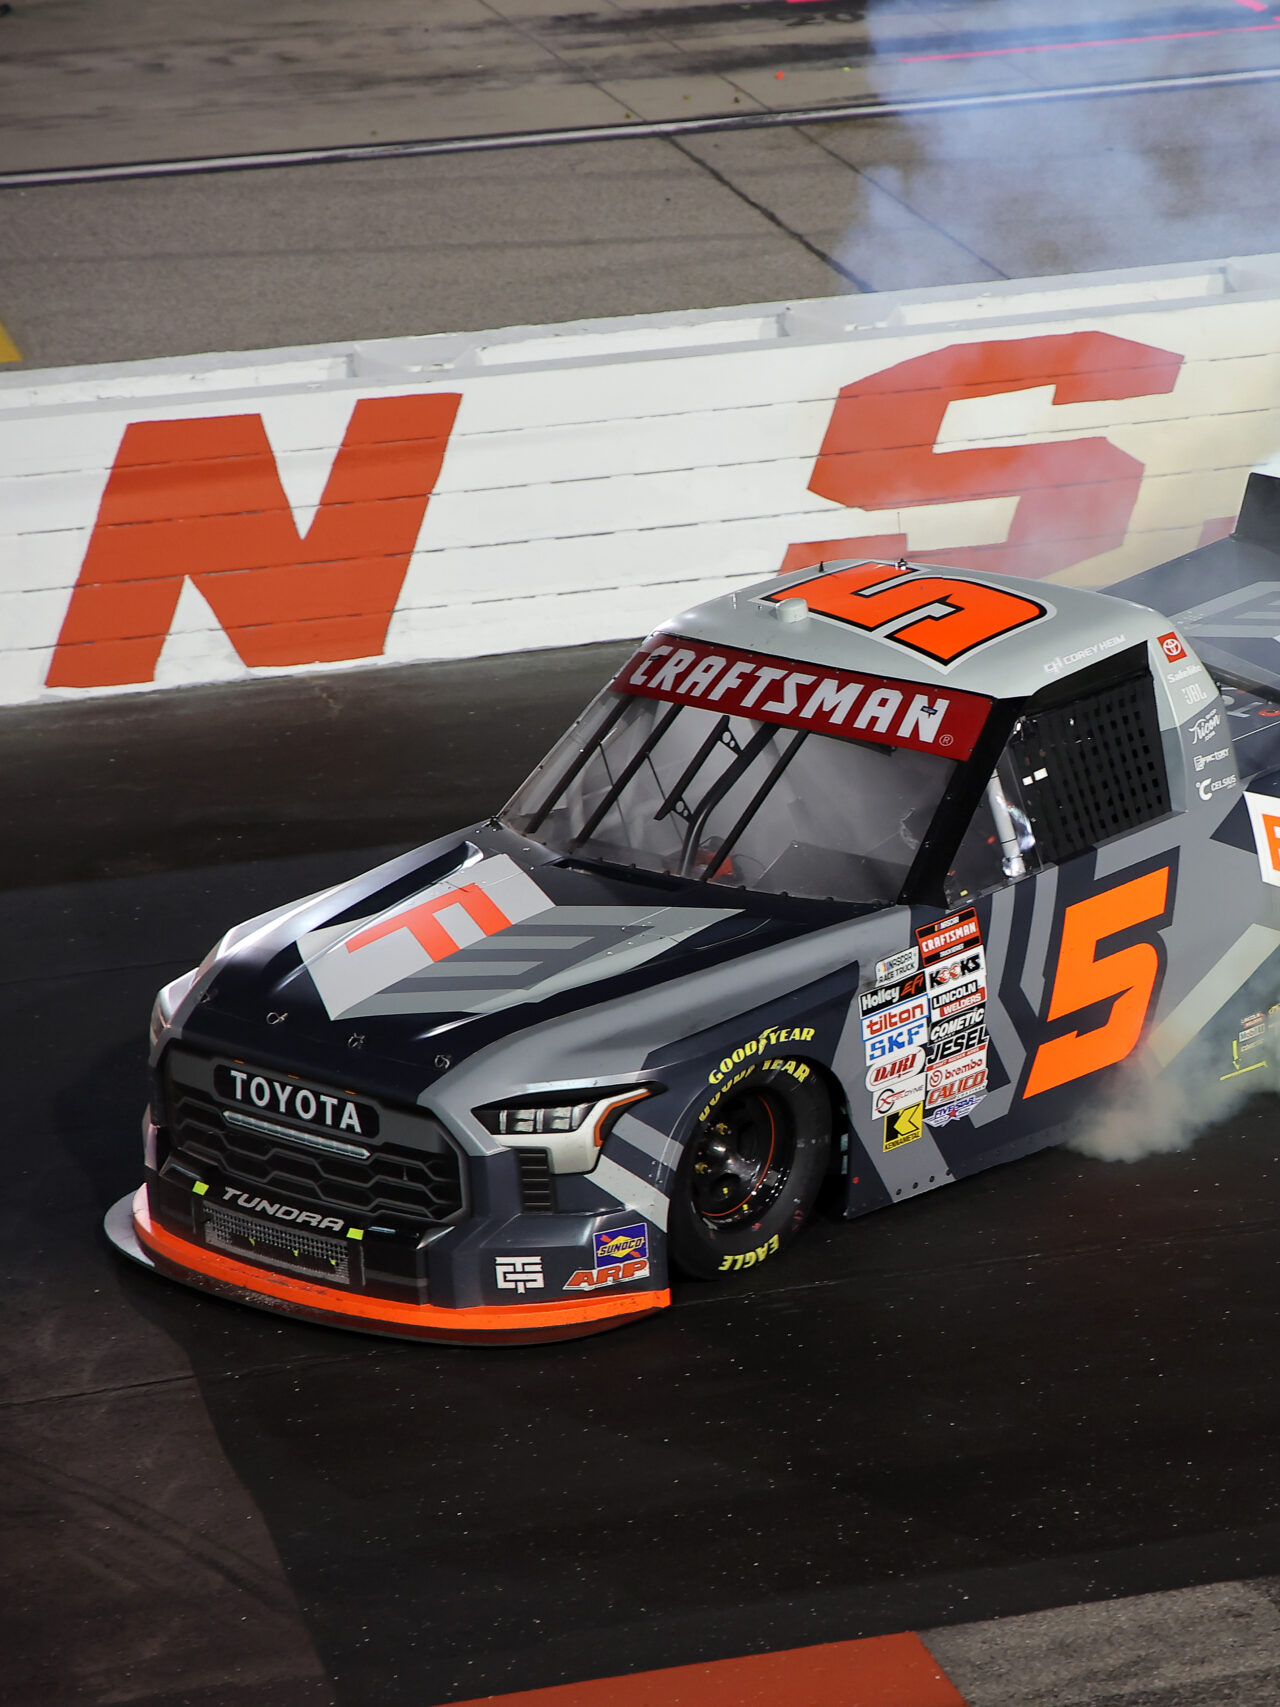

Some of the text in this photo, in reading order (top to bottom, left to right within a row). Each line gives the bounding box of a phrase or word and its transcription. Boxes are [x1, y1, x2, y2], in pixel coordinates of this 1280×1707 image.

[44, 392, 463, 688] N
[757, 559, 1050, 668] 5
[1064, 645, 1098, 665] COREY
[629, 644, 950, 746] CRAFTSMAN
[1182, 683, 1207, 705] JBL
[921, 921, 977, 952] CRAFTSMAN
[895, 962, 915, 976] TRUCK
[1022, 866, 1169, 1100] 5
[861, 986, 900, 1011] Holley
[933, 982, 976, 1008] LINCOLN
[943, 993, 982, 1015] WELDERS
[866, 1003, 924, 1035] tilton
[930, 1008, 985, 1040] COMETIC
[707, 1026, 816, 1084] GOODYEAR
[869, 1023, 924, 1060] SKF
[927, 1026, 989, 1064] JESEL
[944, 1058, 983, 1080] brembo
[230, 1070, 362, 1134] TOYOTA
[927, 1070, 987, 1106] CALICO
[222, 1186, 345, 1232] TUNDRA
[599, 1238, 644, 1256] SUNOCO
[718, 1234, 780, 1271] EAGLE
[567, 1260, 648, 1286] ARP
